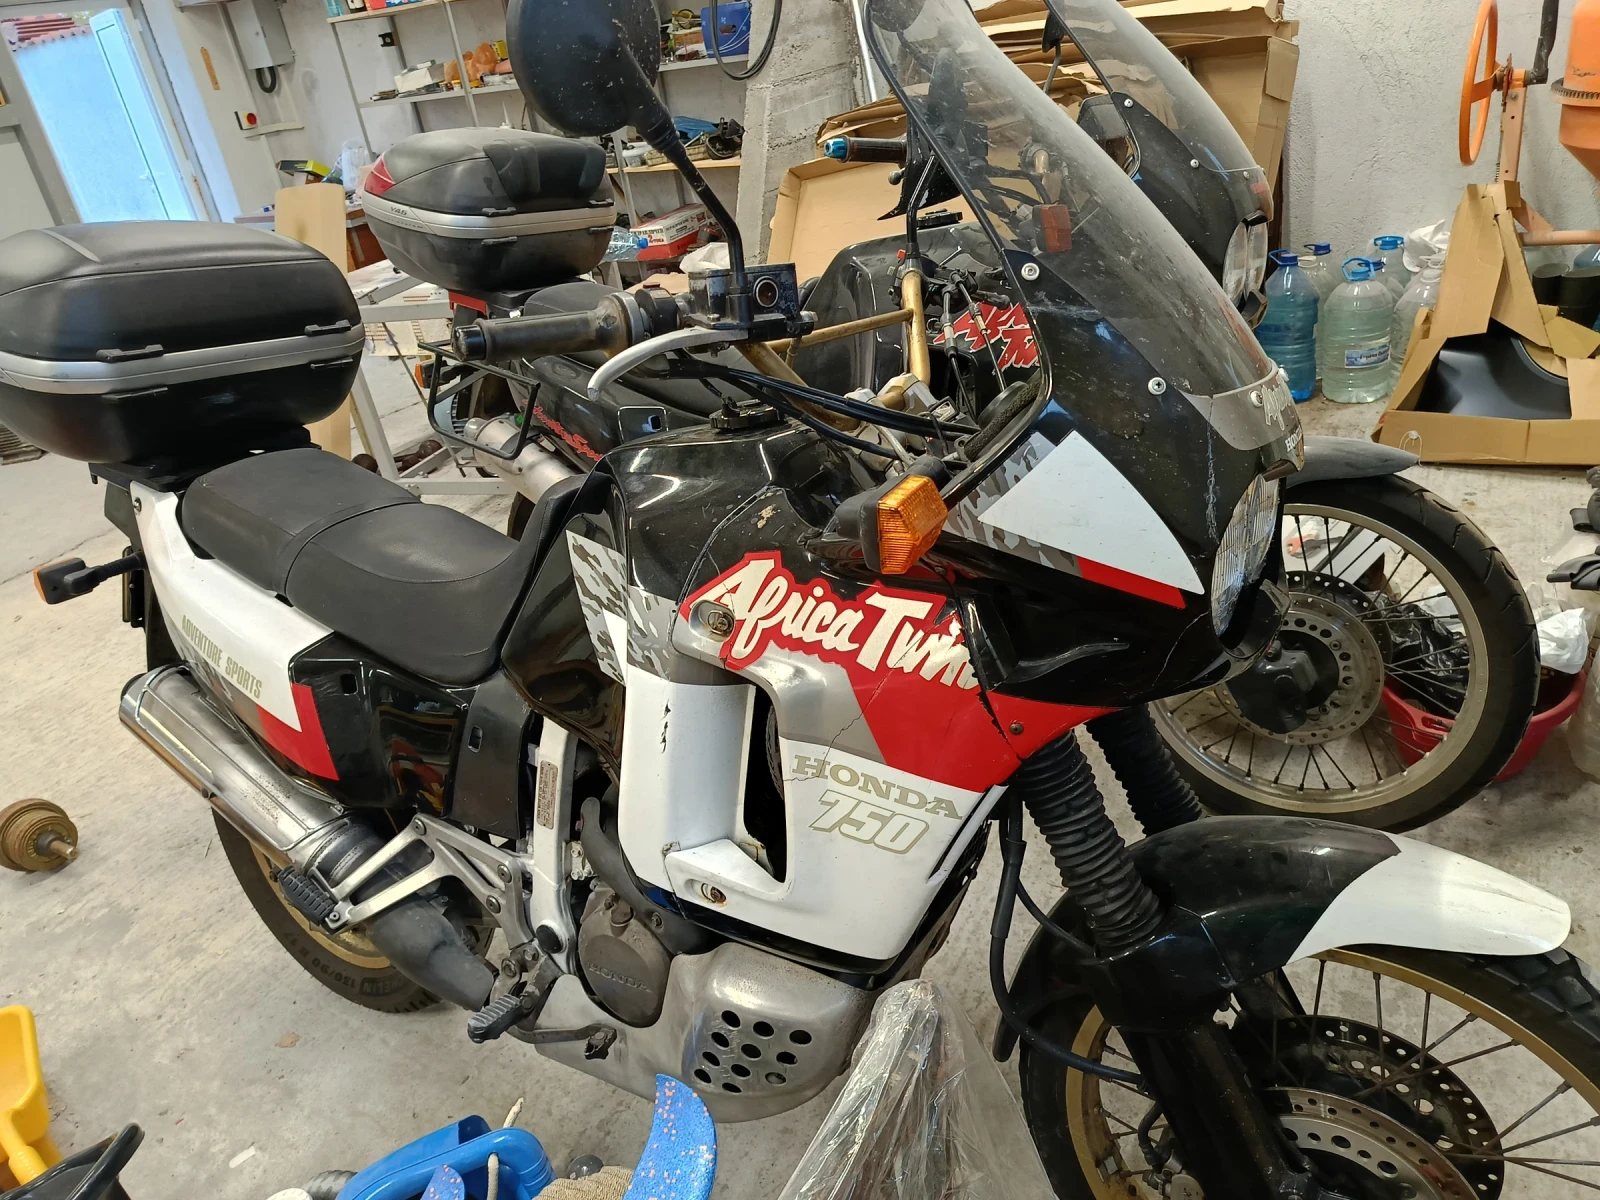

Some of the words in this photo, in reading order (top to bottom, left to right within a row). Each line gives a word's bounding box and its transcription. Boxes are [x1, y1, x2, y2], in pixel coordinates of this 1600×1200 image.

[690, 558, 866, 660] Africa
[181, 614, 223, 668] ADVENTURE
[225, 656, 263, 699] SPORTS
[791, 754, 963, 820] HONDA
[808, 788, 930, 855] 750
[311, 957, 357, 989] 130/90
[588, 961, 653, 993] HONDA
